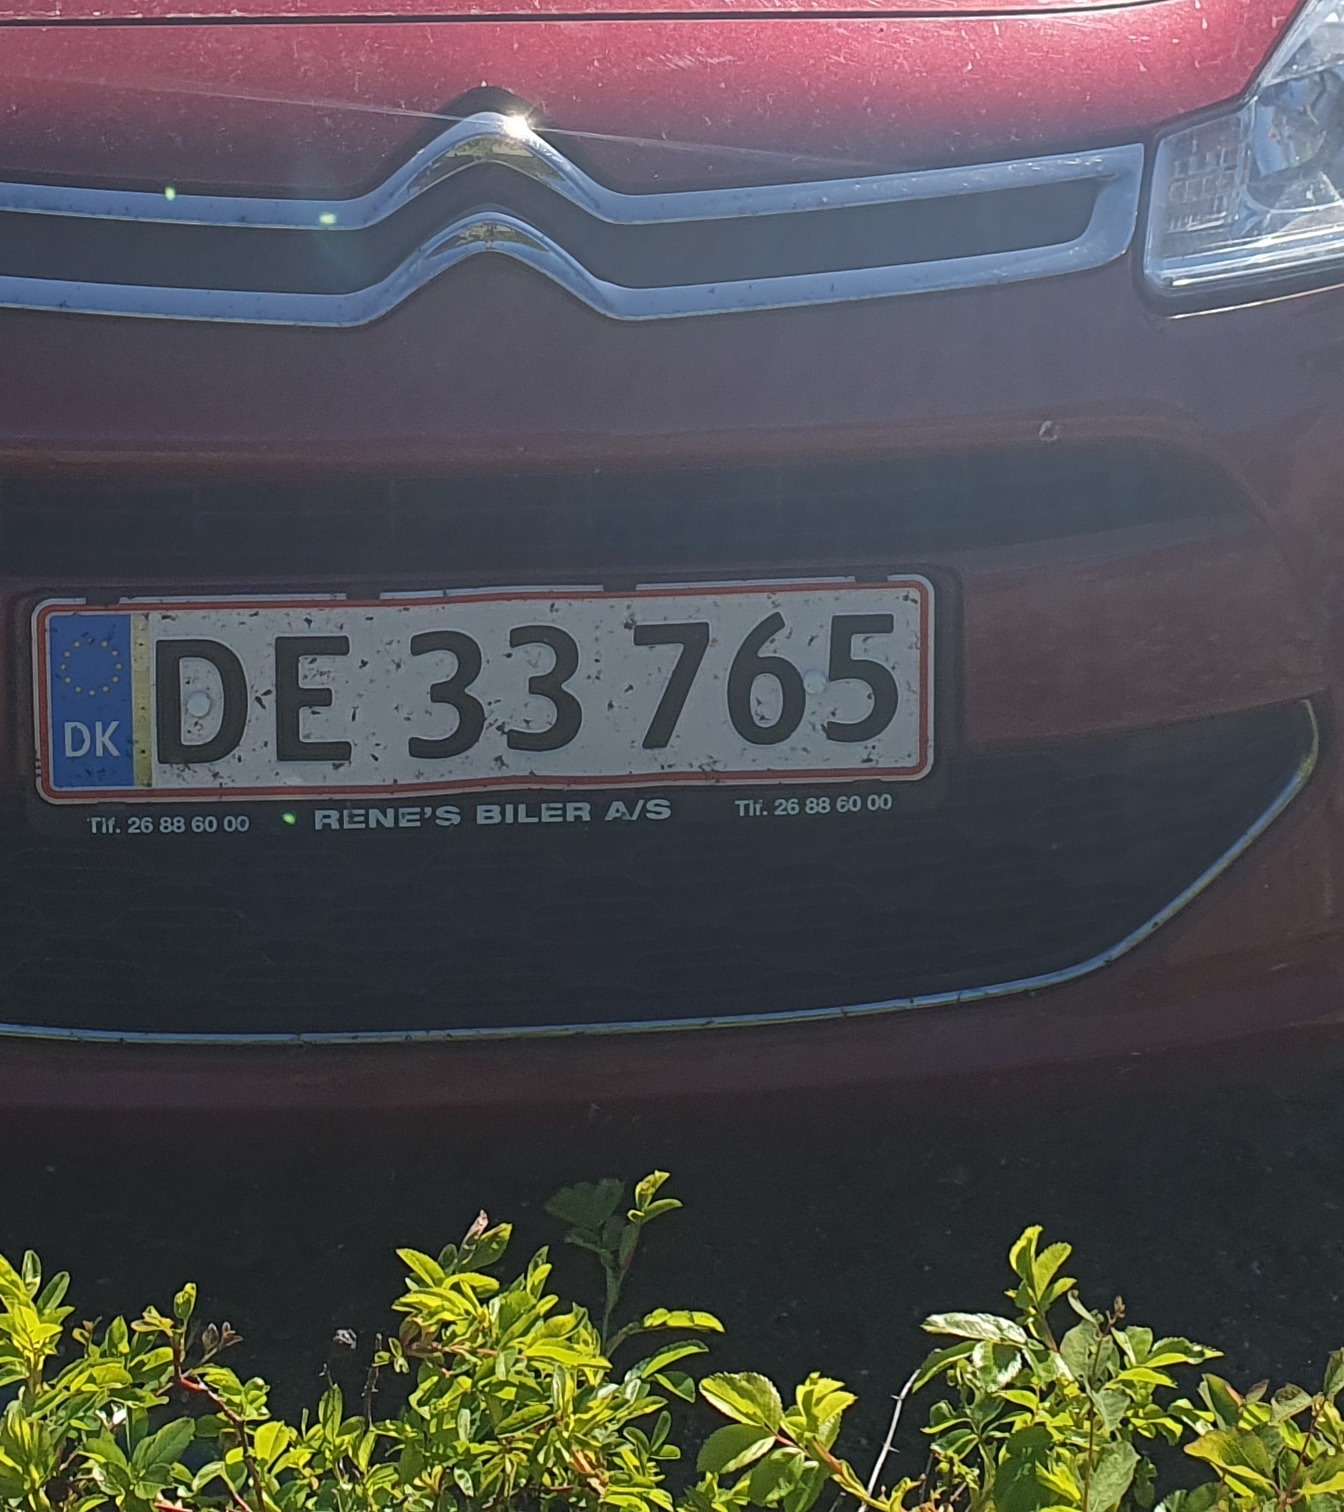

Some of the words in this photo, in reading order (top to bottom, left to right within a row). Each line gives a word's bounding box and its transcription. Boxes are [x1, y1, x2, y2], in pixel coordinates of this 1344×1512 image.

[155, 634, 354, 766] DE
[407, 623, 585, 759] 33
[632, 610, 900, 749] 765
[62, 720, 121, 759] DK
[314, 805, 462, 830] RENE'S
[476, 801, 592, 826] BILER
[604, 799, 672, 821] A/S
[774, 798, 800, 816] 26
[805, 797, 831, 815] 88
[836, 795, 861, 813] 60
[866, 793, 893, 811] 00
[127, 816, 153, 834] 26
[158, 816, 185, 834] 88
[191, 815, 217, 833] 60
[223, 815, 250, 832] 00
